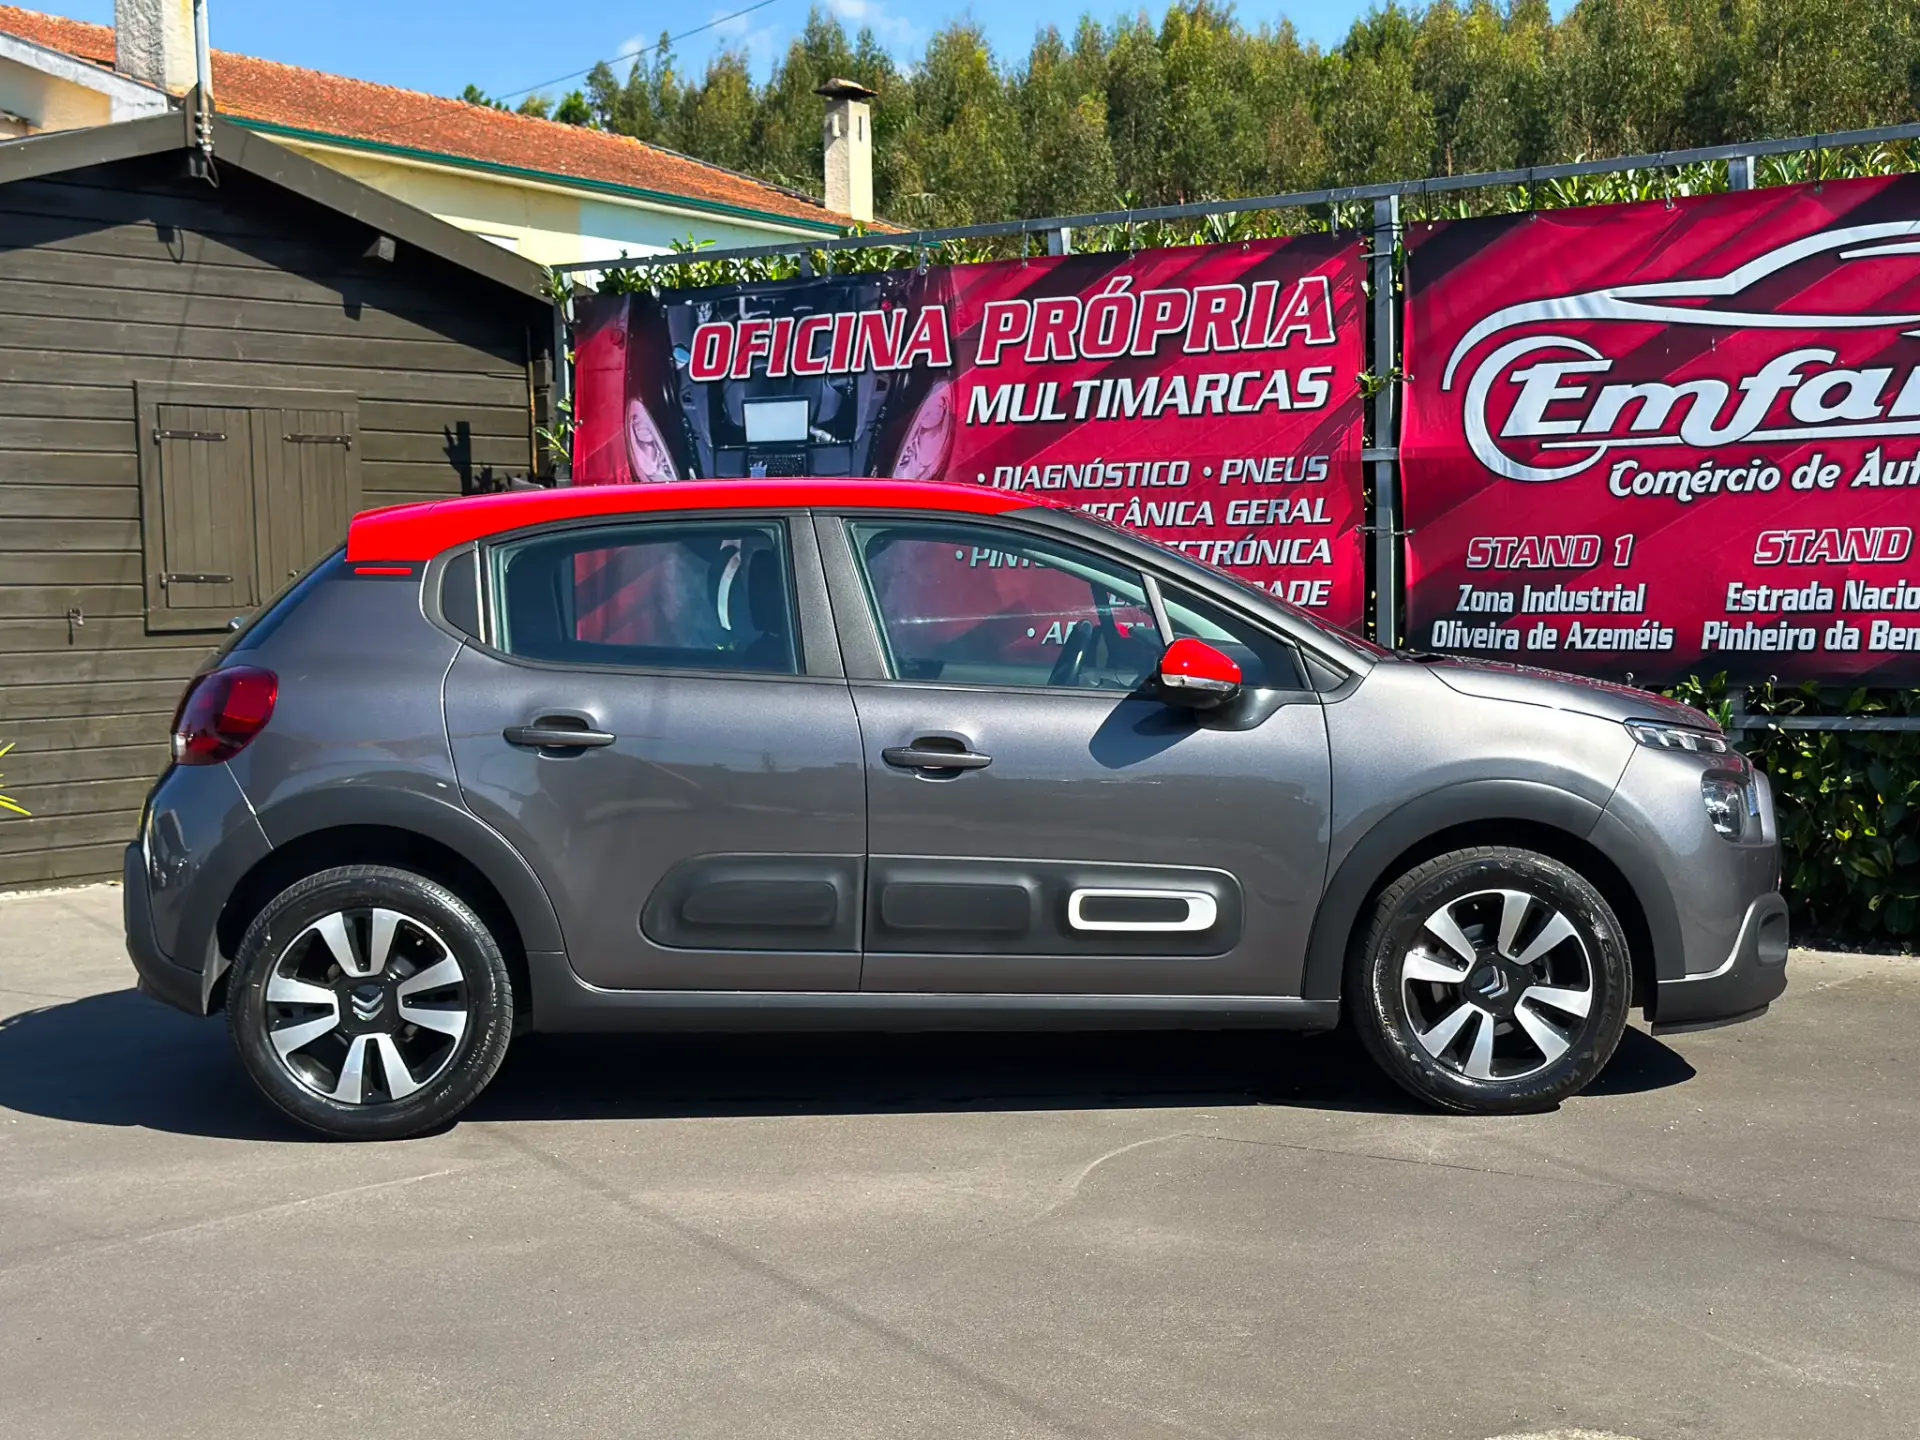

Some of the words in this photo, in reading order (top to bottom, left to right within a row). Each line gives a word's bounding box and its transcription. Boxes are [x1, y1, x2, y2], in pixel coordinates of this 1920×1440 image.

[689, 305, 952, 382] OFICINA
[975, 276, 1337, 365] PRÓPRIA
[966, 366, 1332, 424] MULTIMARCAS
[992, 458, 1190, 490] DIAGNÓSTICO
[1219, 455, 1330, 485] PNEUS
[1609, 457, 1780, 501] Comércio
[1791, 453, 1842, 489] de
[1226, 498, 1332, 524] GERAL
[1466, 535, 1601, 568] STAND
[1613, 533, 1636, 567] 1
[1753, 526, 1913, 565] STAND
[1457, 584, 1514, 613] Zona
[1521, 583, 1647, 613] Industrial
[1726, 580, 1834, 612] Estrada
[1432, 619, 1519, 650] Oliveira
[1527, 621, 1557, 650] de
[1564, 619, 1674, 650] Azeméis
[1702, 620, 1816, 651] Pinheiro
[1824, 620, 1860, 650] da
